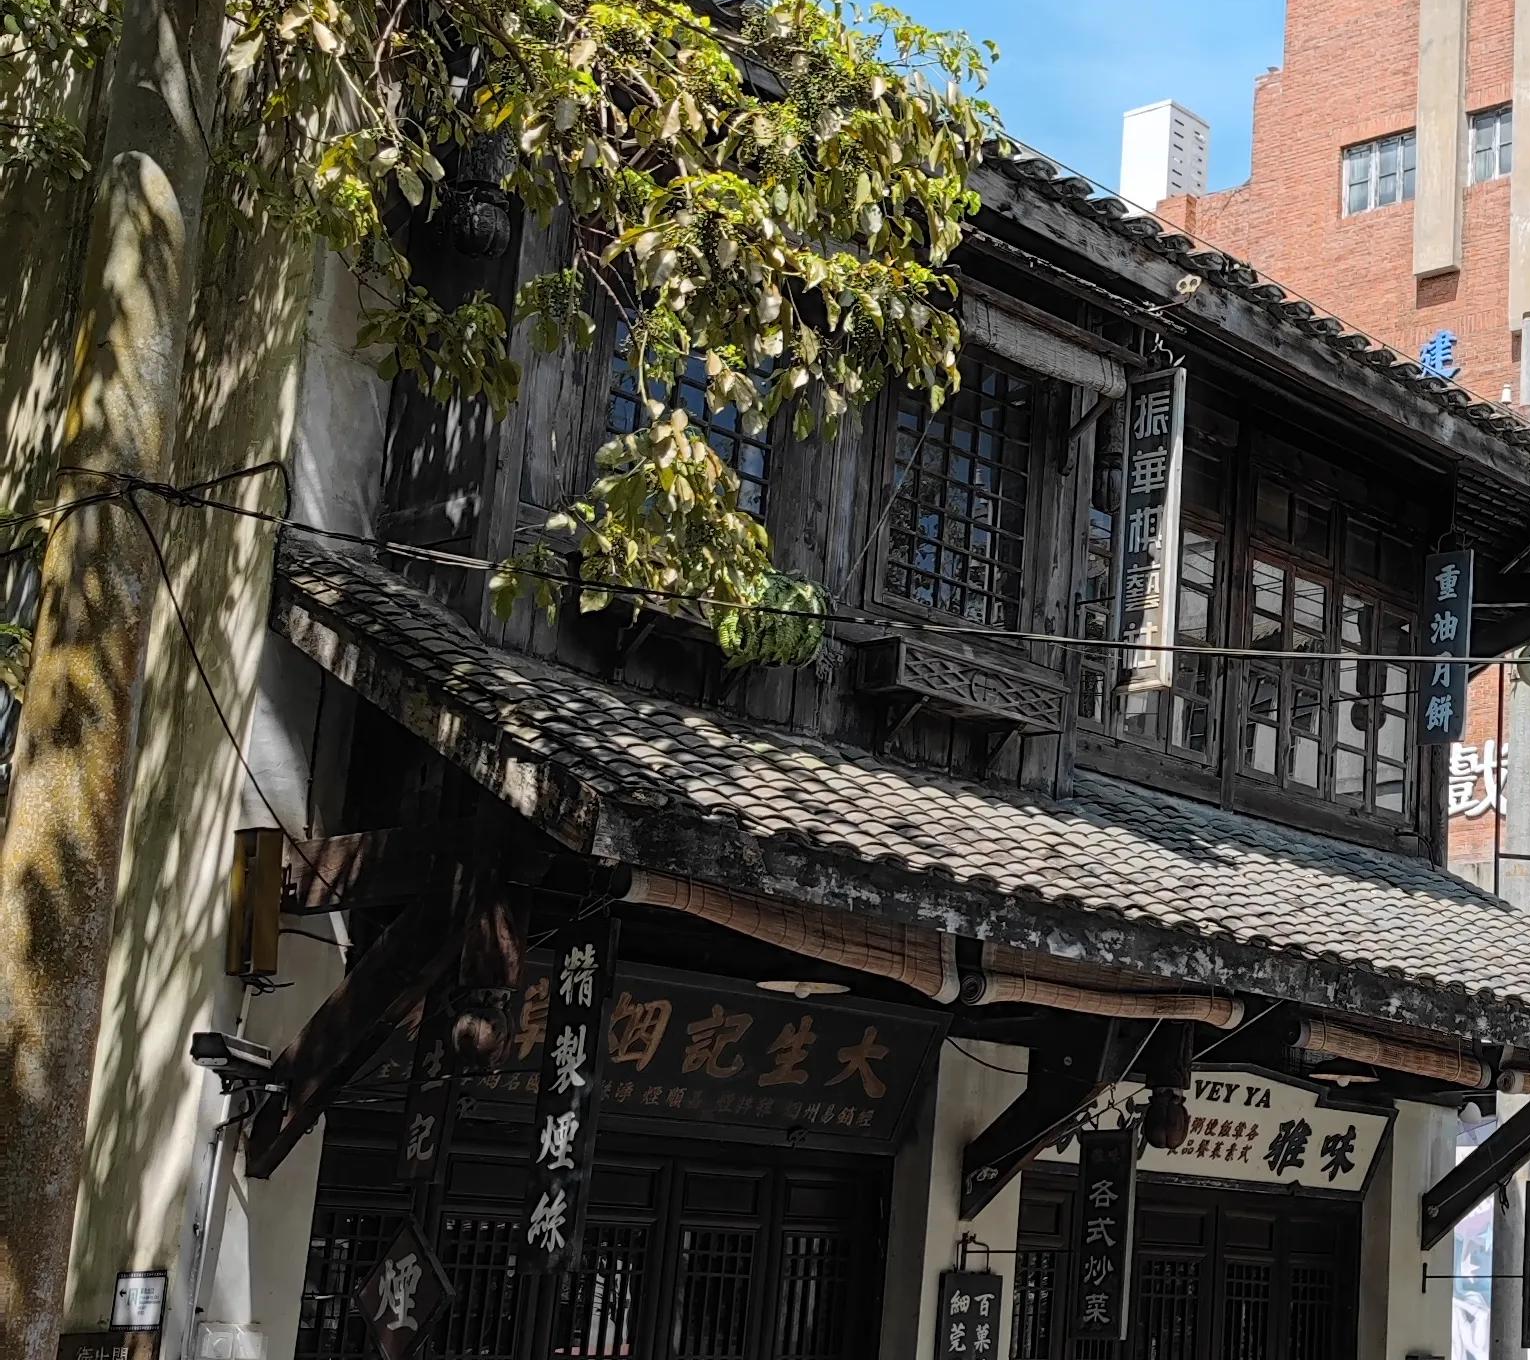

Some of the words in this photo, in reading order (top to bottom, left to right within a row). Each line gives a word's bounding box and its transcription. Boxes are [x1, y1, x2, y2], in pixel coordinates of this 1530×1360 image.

[1195, 1079, 1239, 1104] VEY
[1243, 1086, 1272, 1109] YA
[1085, 1179, 1118, 1324] 各式炒菜
